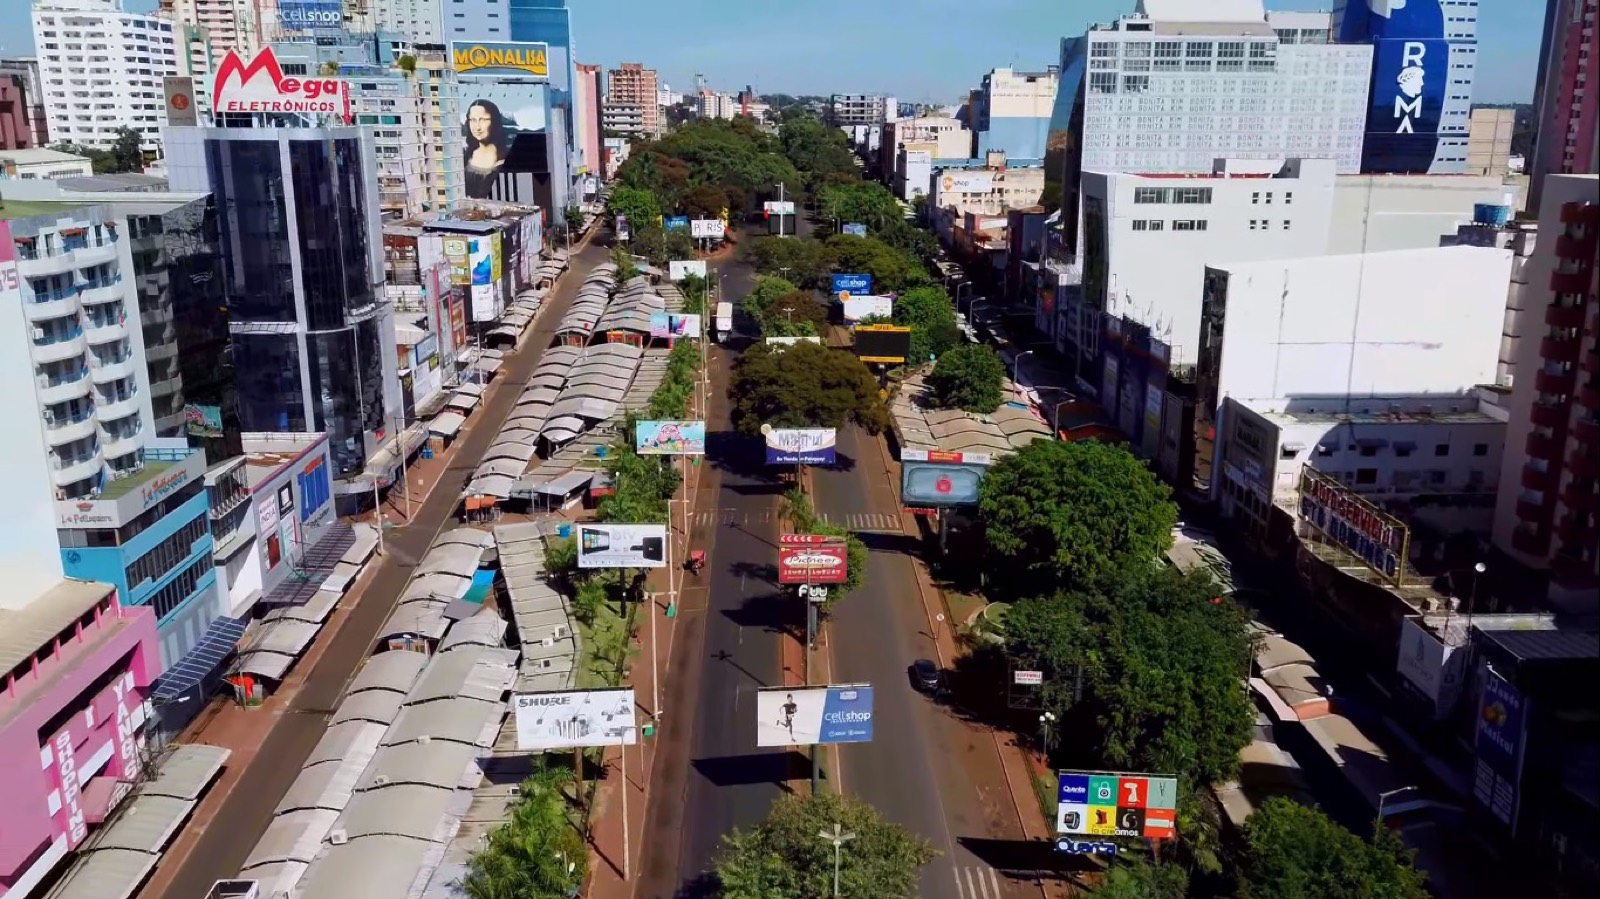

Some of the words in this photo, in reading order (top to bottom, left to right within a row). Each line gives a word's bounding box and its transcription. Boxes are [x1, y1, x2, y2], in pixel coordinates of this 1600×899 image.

[454, 45, 545, 67] MONALISA
[213, 46, 338, 114] Mega
[227, 99, 335, 112] ELETRÔNICOS
[836, 277, 866, 287] cellshop
[518, 696, 571, 707] SHURE
[825, 710, 871, 721] cellshop
[56, 731, 86, 843] SHOPPING
